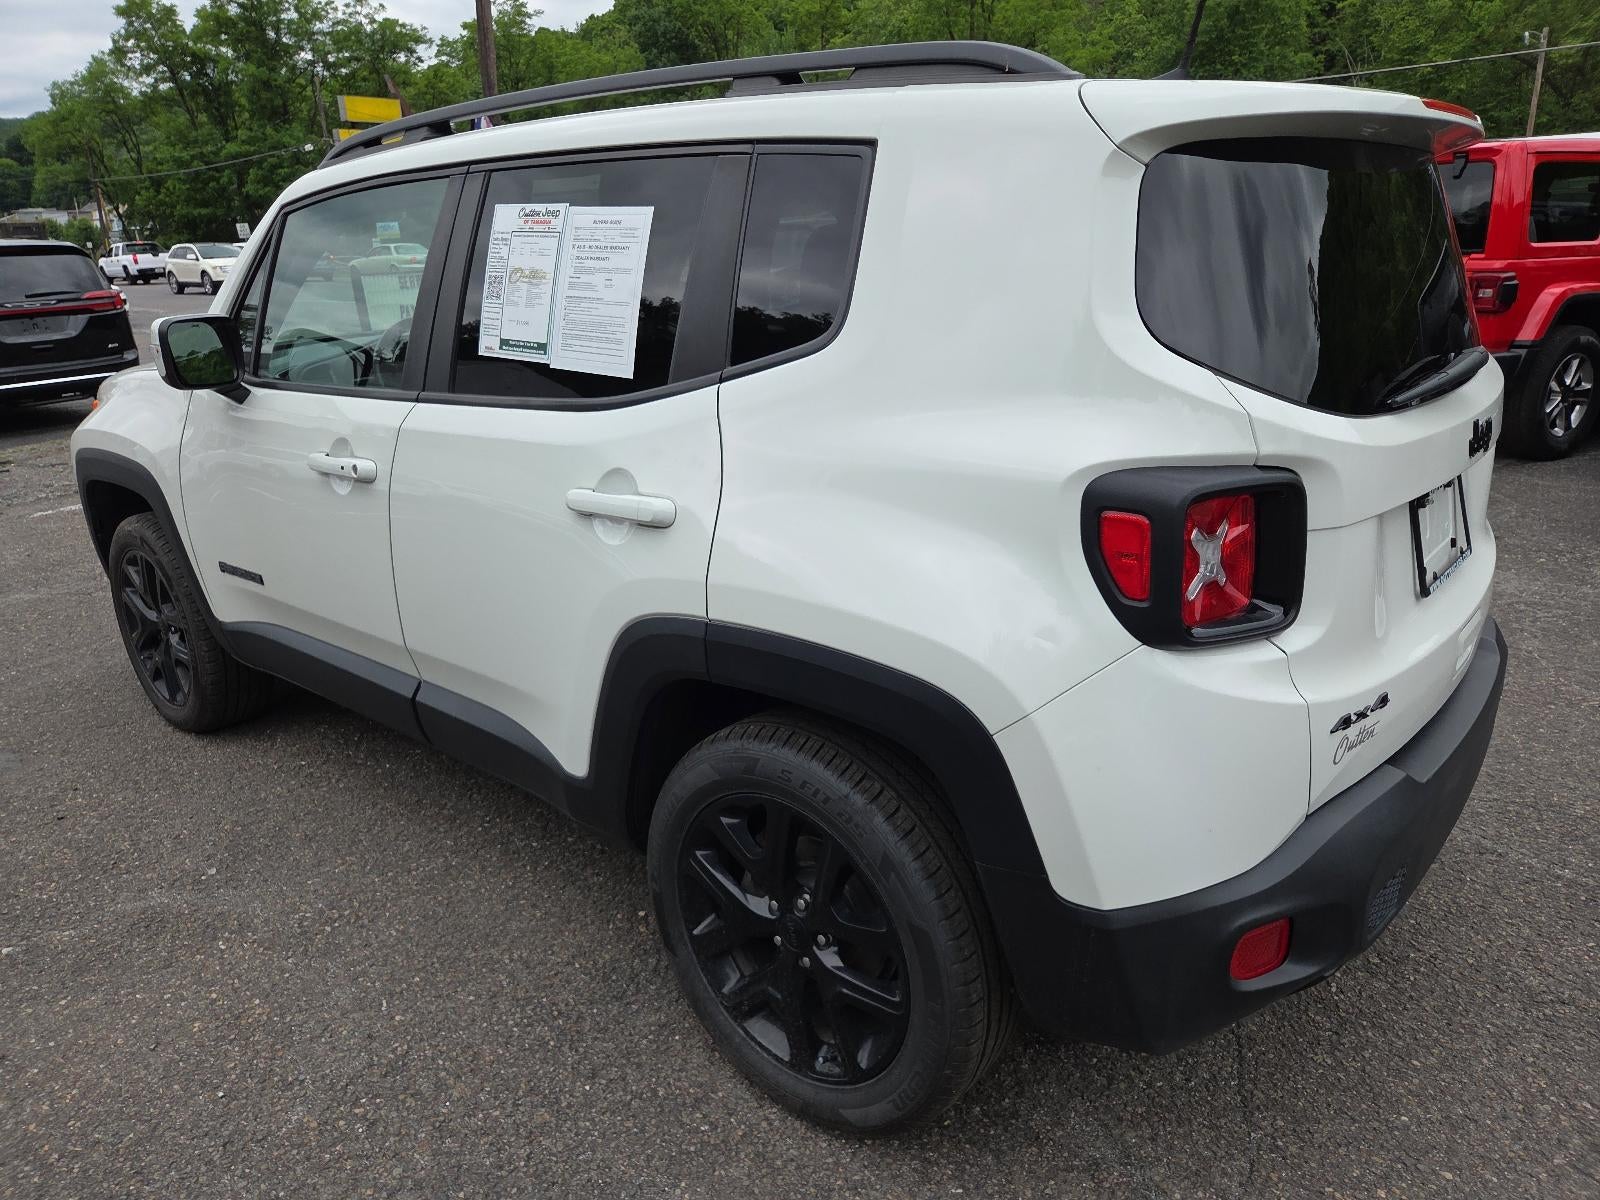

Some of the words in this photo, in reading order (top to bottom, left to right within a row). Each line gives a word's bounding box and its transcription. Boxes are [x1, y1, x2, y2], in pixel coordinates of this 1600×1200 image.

[542, 207, 561, 219] Jeep
[1333, 720, 1380, 765] Outten
[800, 780, 833, 806] FIT
